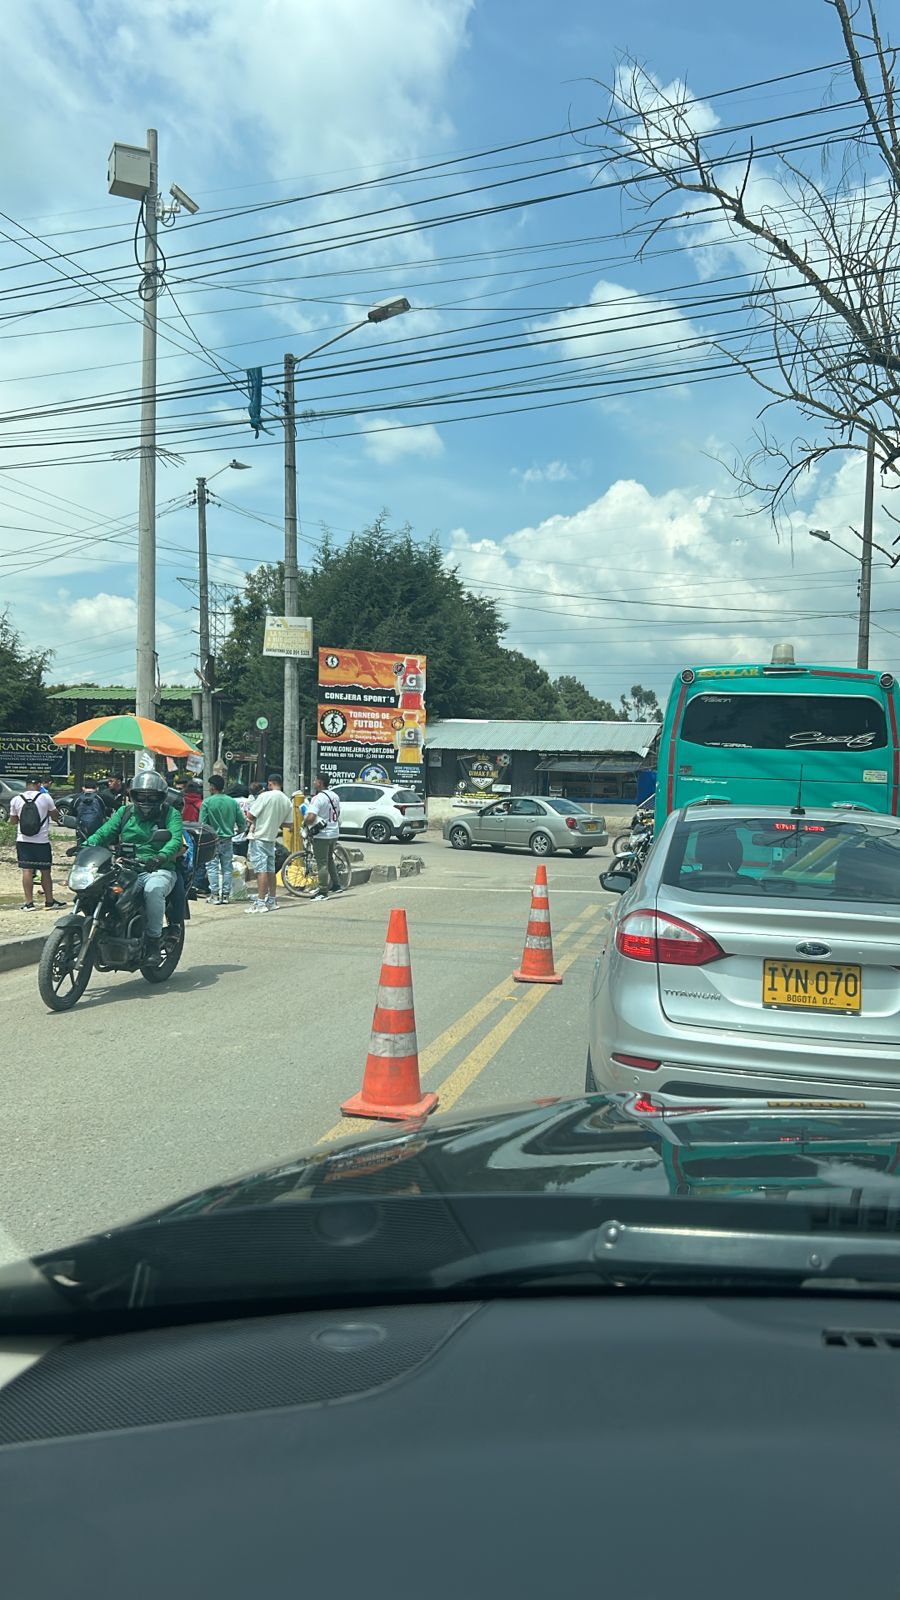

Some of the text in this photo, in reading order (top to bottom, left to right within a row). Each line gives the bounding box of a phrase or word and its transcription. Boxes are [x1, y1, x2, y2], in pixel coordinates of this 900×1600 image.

[406, 675, 417, 686] G
[325, 692, 361, 702] CONEJERA
[349, 711, 378, 720] TORNEOS
[353, 719, 383, 729] FUTBOL
[405, 728, 415, 740] G
[320, 745, 394, 754] WWW.CONEJERASPORT.COM
[767, 966, 858, 998] IYN 070
[663, 990, 722, 1000] TITANIUM
[786, 994, 818, 1005] BOGOTA
